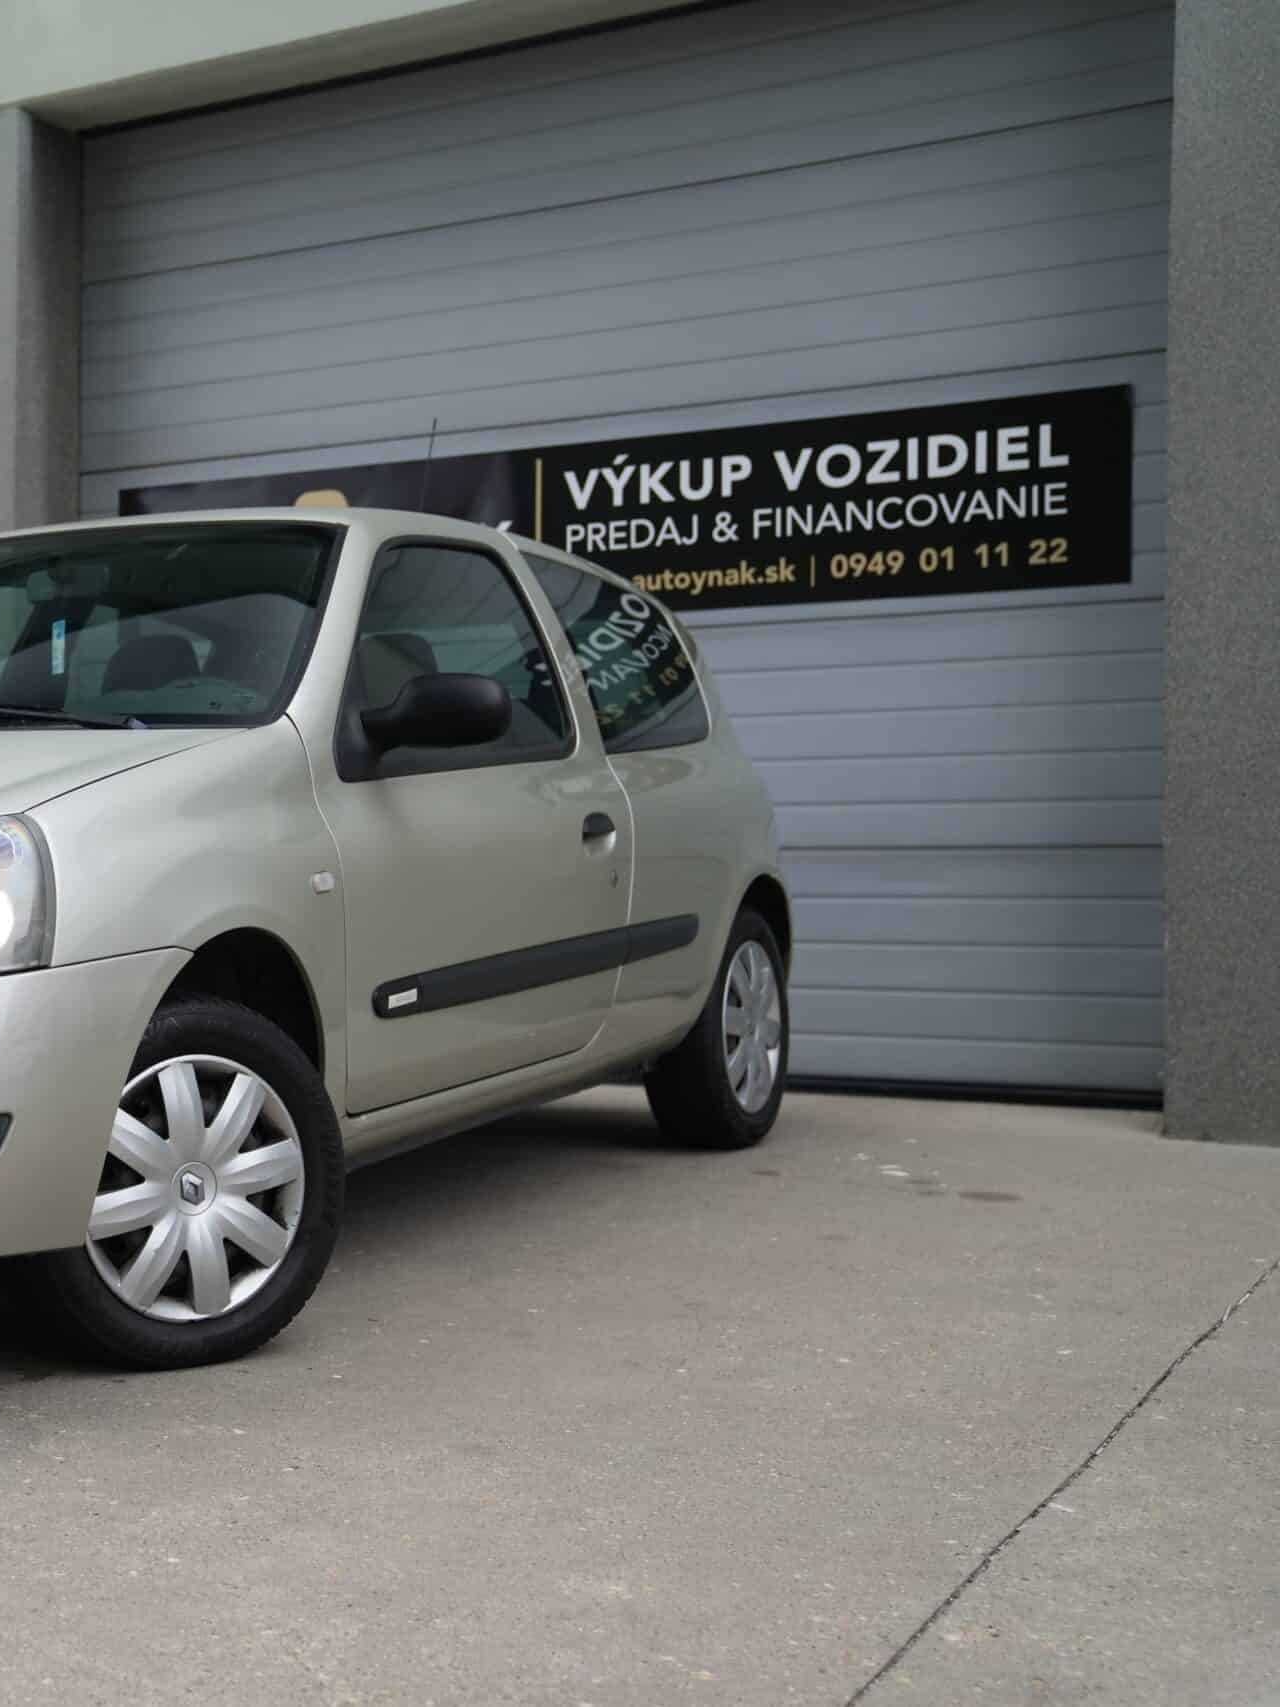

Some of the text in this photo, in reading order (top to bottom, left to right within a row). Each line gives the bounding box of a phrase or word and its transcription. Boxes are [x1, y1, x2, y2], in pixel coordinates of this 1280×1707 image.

[563, 423, 1070, 511] VÝKUP VOZIDIEL
[565, 482, 1069, 553] PREDAJ & FINANCOVANIE
[631, 537, 1069, 595] autoynak.sk 0949 01 11 22
